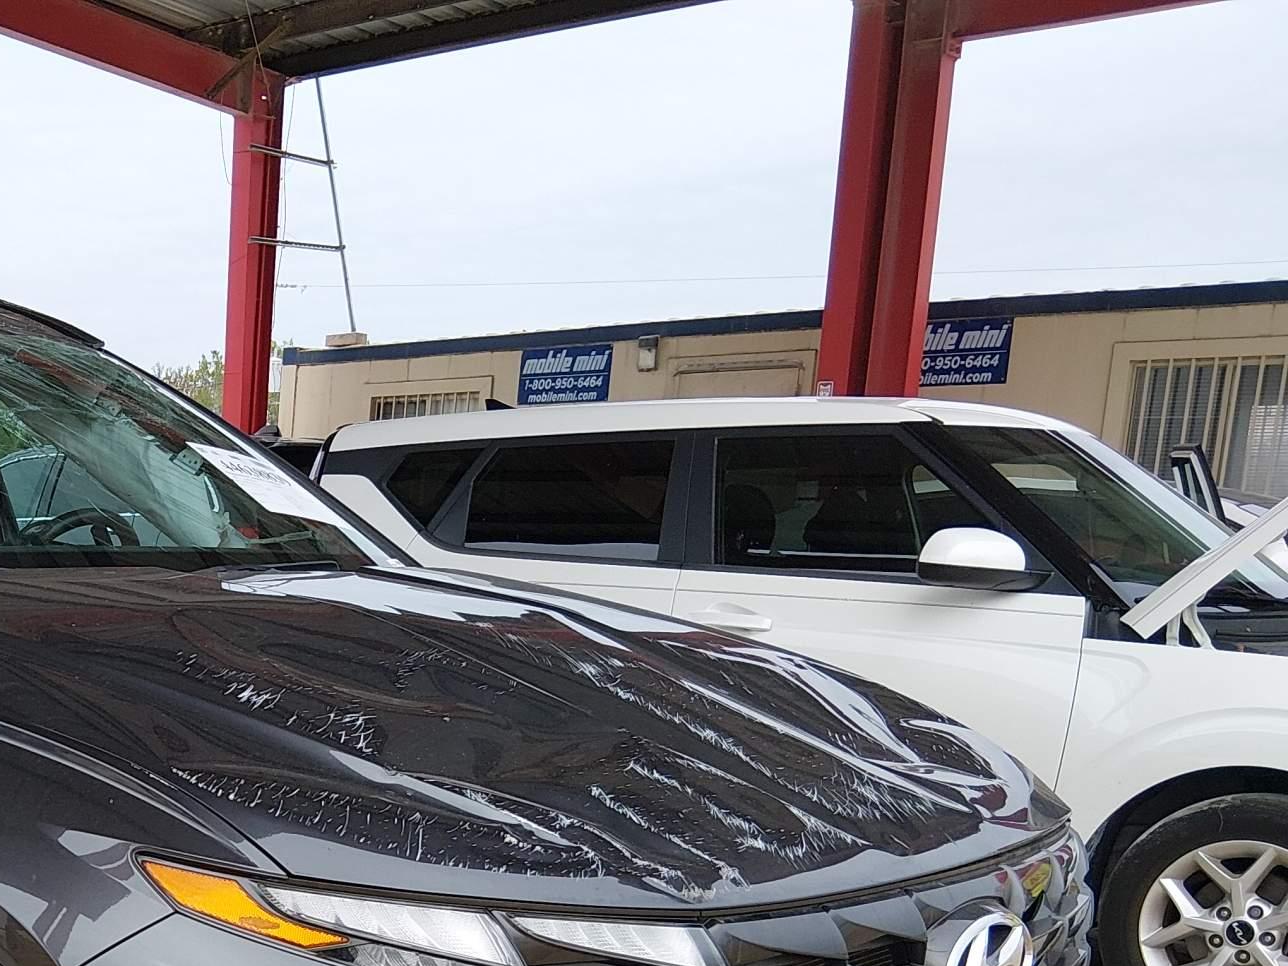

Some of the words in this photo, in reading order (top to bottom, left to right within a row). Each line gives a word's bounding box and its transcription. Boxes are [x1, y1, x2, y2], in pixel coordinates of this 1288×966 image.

[922, 323, 959, 351] bile
[959, 324, 1009, 349] mini
[522, 349, 573, 374] mobile
[572, 350, 609, 372] mini
[920, 354, 1000, 370] 0-950-6464
[524, 376, 603, 391] 1-800-950-6464
[527, 390, 598, 403] mobilemini.com
